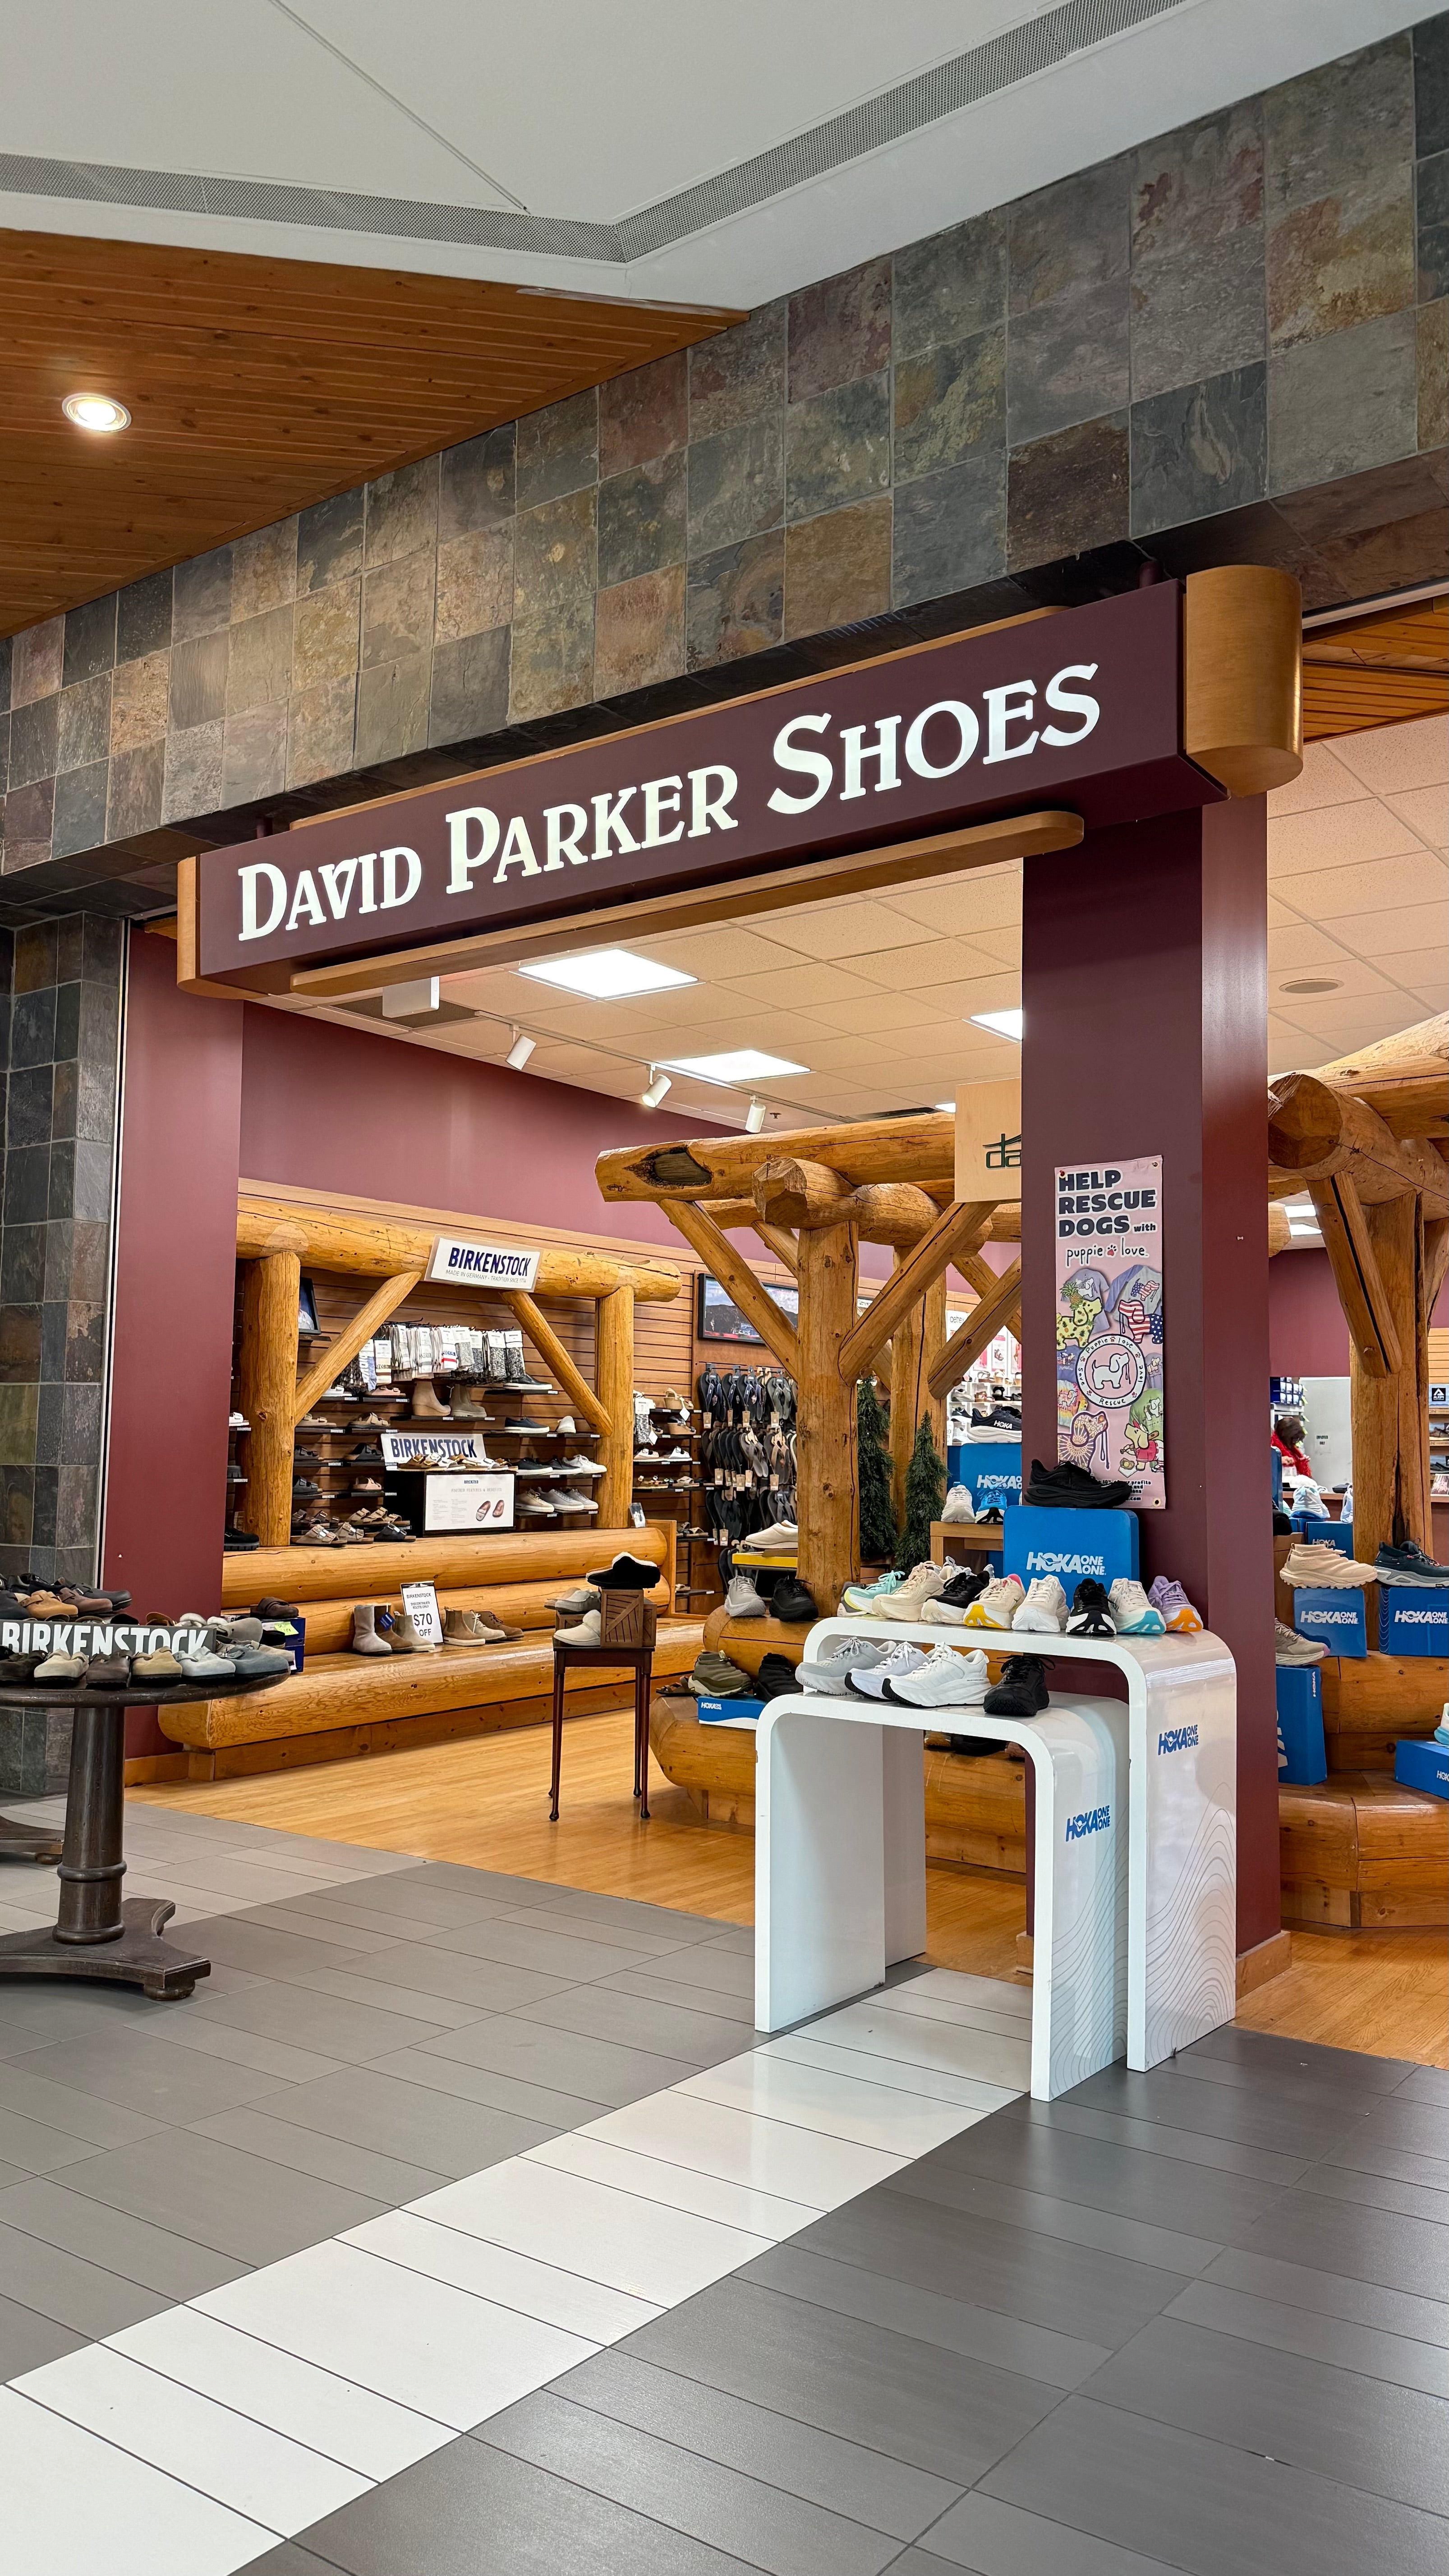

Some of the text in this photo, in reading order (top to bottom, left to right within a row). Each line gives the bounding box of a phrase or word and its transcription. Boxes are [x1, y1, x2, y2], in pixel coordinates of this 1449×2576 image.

[238, 663, 1100, 941] DAVID PARKER SHOES
[1059, 1170, 1121, 1191] HELP
[1059, 1190, 1156, 1214] RESCUE
[1059, 1215, 1156, 1237] DOGS with
[448, 1247, 531, 1276] BIRKENSTOCK
[1067, 1245, 1103, 1266] puppie
[1099, 1398, 1126, 1406] Rescue
[994, 1420, 1012, 1429] HOKA
[390, 1438, 477, 1458] BIRKENSTOCK
[976, 1475, 1017, 1489] HOKA
[1026, 1552, 1104, 1574] HOKA ONE
[413, 1613, 432, 1628] $70
[1300, 1610, 1342, 1624] HOKA
[1394, 1610, 1433, 1624] HOKA
[2, 1622, 208, 1658] BIRKENSTOCK
[419, 1628, 432, 1637] OFF
[1158, 1724, 1198, 1756] HOKA ONE
[1187, 1734, 1199, 1748] ONE
[1066, 1805, 1110, 1842] HOKA ONE
[1098, 1816, 1110, 1830] ONE
